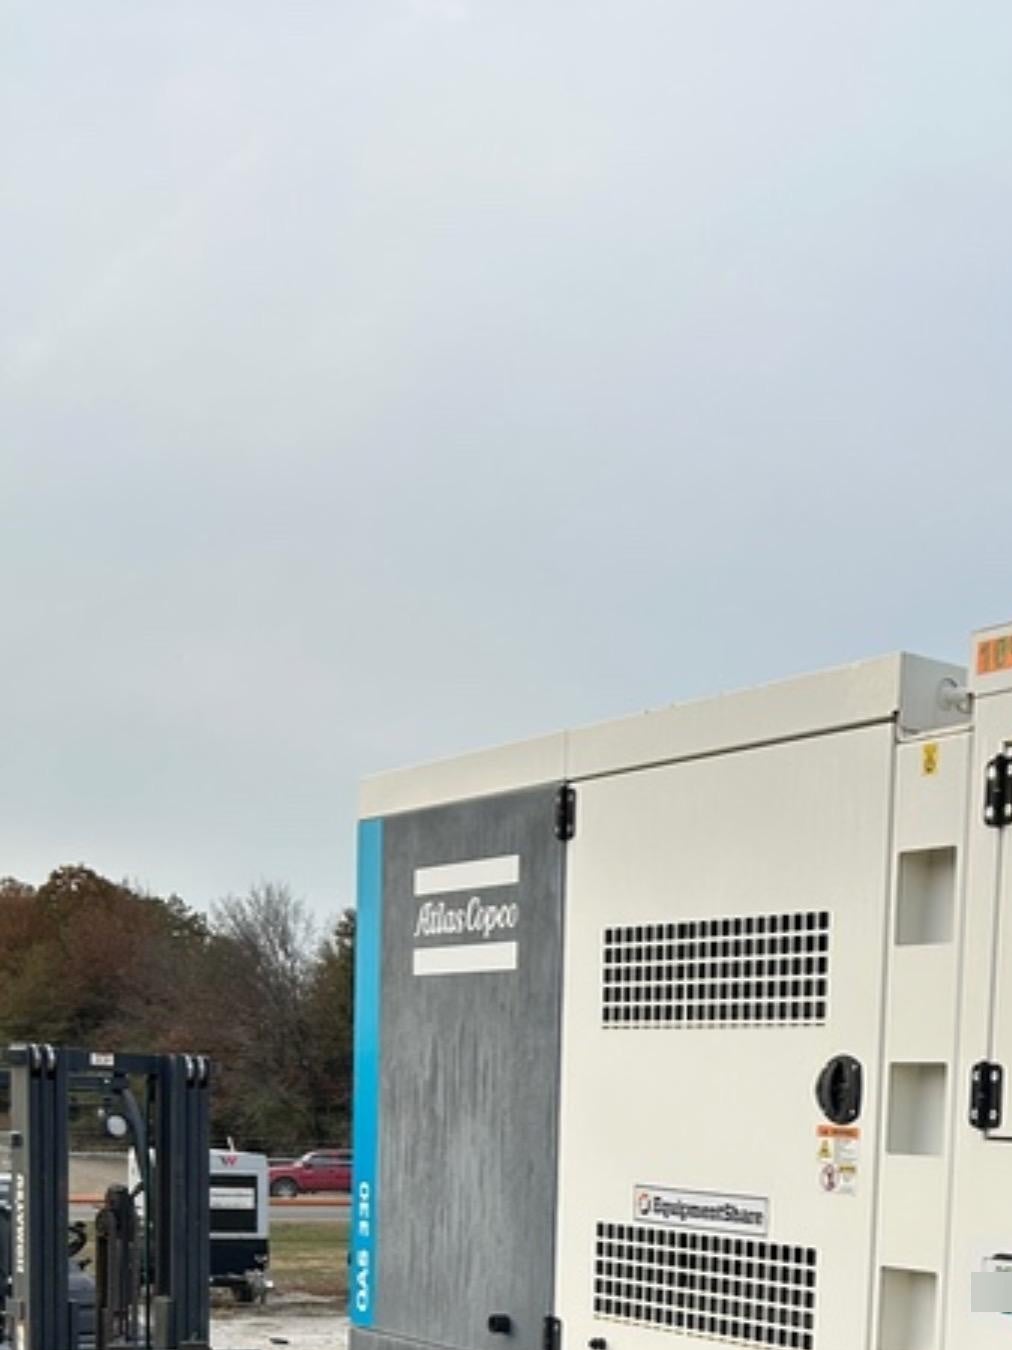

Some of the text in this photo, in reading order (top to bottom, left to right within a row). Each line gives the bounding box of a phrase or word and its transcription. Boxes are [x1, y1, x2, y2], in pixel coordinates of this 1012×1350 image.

[413, 896, 518, 937] Atlas Copco
[653, 1196, 763, 1224] EquipmentShare
